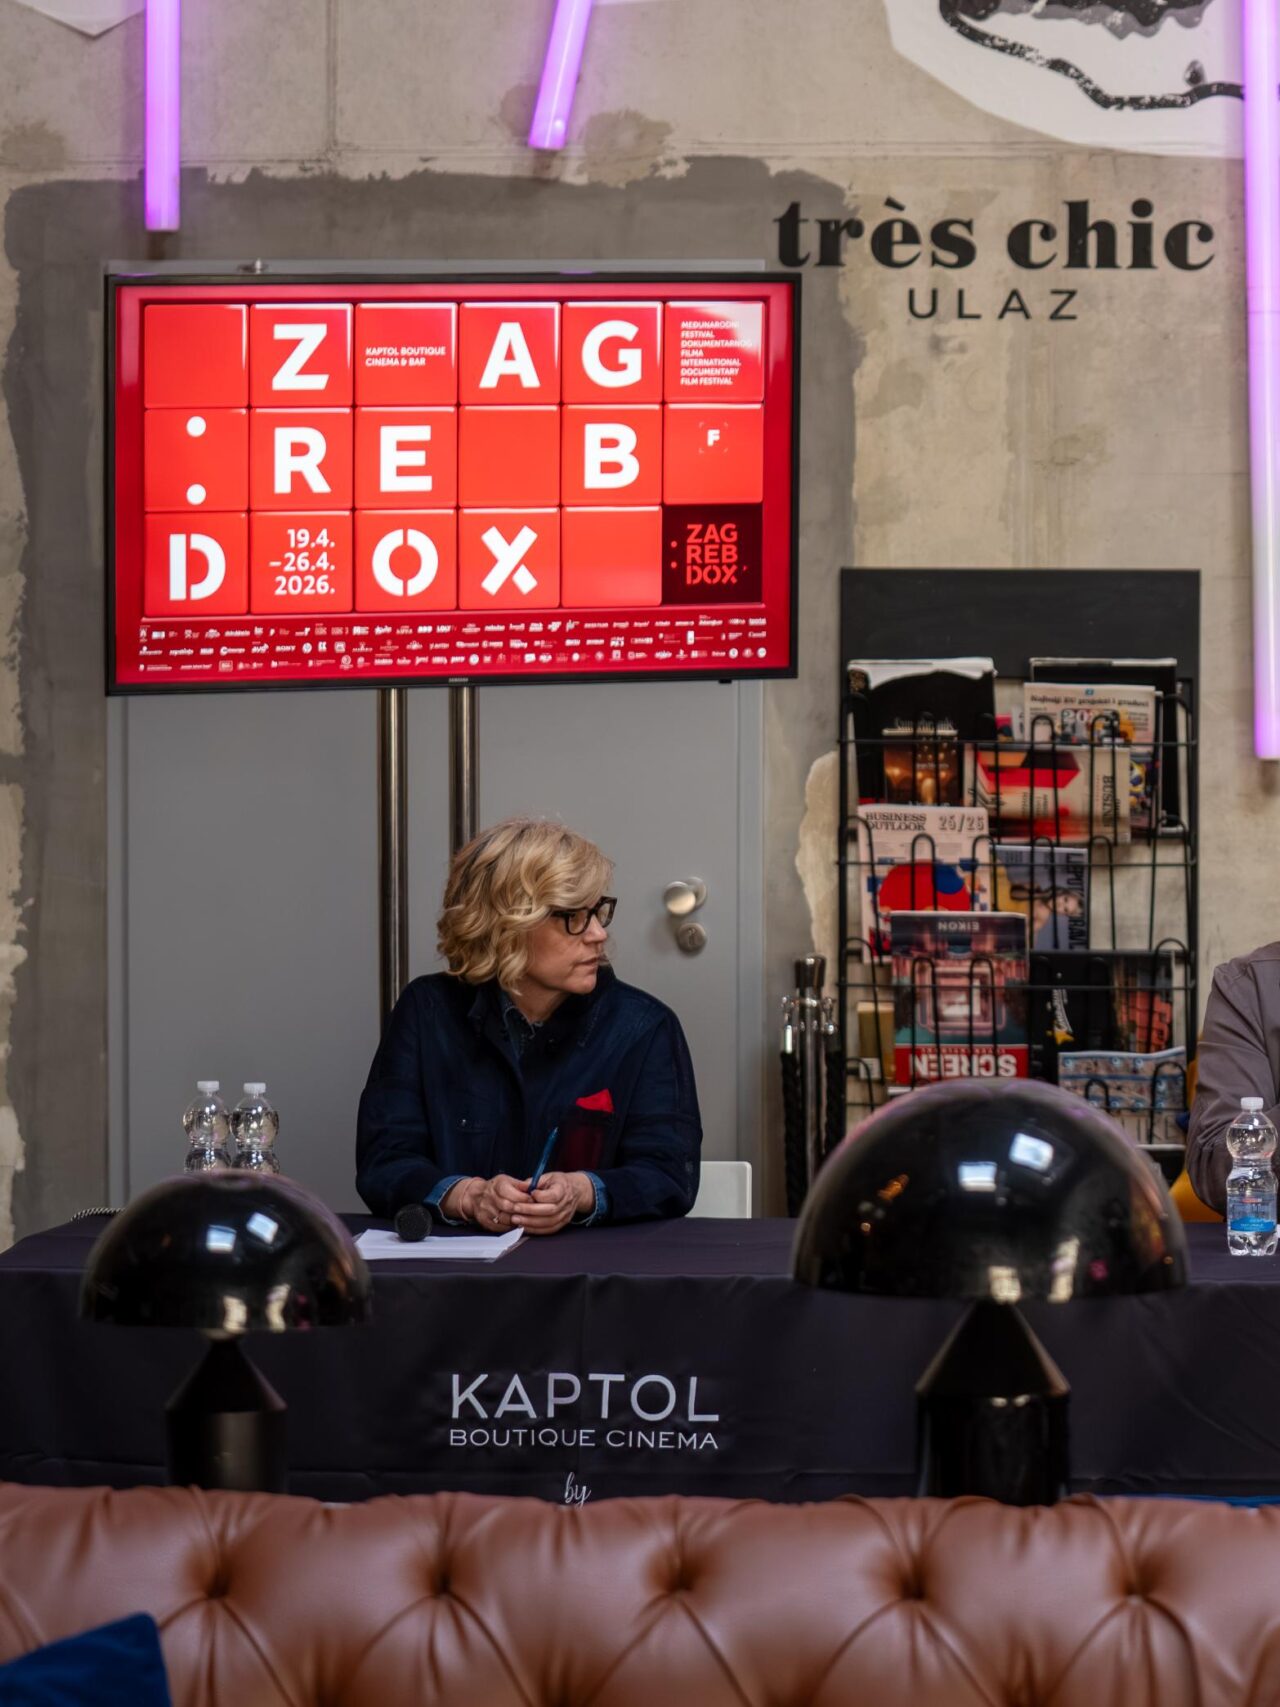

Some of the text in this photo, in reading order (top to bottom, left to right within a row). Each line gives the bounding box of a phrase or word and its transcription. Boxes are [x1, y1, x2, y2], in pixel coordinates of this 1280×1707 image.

[774, 197, 1215, 271] très chic
[908, 288, 1079, 320] ULAZ
[681, 330, 715, 338] FESTIVAL
[365, 346, 446, 356] KAPTOL BOUTIQUE
[681, 349, 704, 357] FILMA
[365, 357, 399, 366] CINEMA
[408, 357, 426, 366] BAR
[681, 358, 742, 367] INTERNATIONAL
[681, 367, 739, 376] DOCUMENTARY
[680, 377, 733, 386] FILM FESTIVAL
[287, 528, 335, 548] 19.4.
[686, 523, 738, 543] ZAG
[686, 544, 738, 564] REB
[686, 565, 738, 584] DOX
[274, 575, 335, 595] 2026.
[865, 811, 927, 821] BUSINESS
[938, 921, 980, 931] EIKON
[909, 1053, 1018, 1077] SCREEN
[451, 1372, 720, 1422] KAPTOL
[450, 1429, 719, 1449] BOUTIQUE CINEMA
[564, 1472, 592, 1509] by
